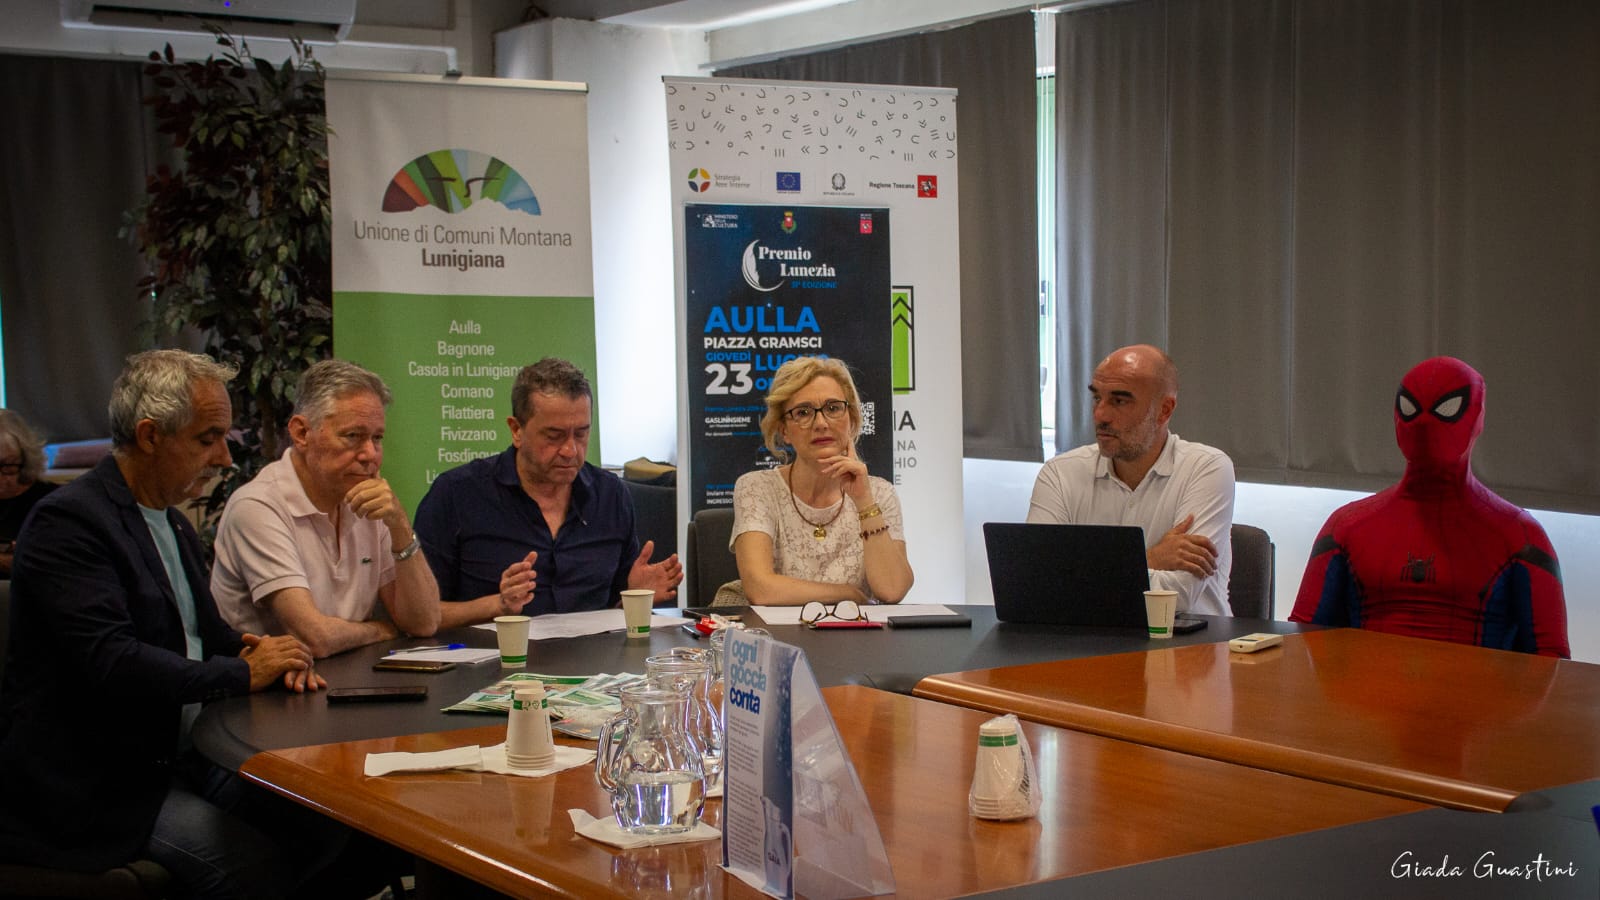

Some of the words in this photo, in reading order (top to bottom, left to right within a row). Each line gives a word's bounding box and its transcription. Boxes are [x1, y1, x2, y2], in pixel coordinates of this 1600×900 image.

[354, 221, 410, 242] Unione
[414, 225, 429, 243] di
[433, 226, 495, 244] Comuni
[499, 227, 572, 247] Montana
[421, 248, 505, 271] Lunigiana
[758, 246, 812, 260] Premio
[780, 263, 836, 277] Lunezia
[449, 320, 481, 334] Aulla
[704, 306, 820, 333] AULLA
[437, 341, 495, 358] Bagnone
[704, 337, 757, 349] PIAZZA
[759, 337, 822, 348] GRAMSCI
[408, 361, 449, 377] Casola
[452, 363, 464, 377] in
[704, 363, 753, 395] 23
[441, 384, 494, 399] Comano
[441, 406, 494, 420] Filattiera
[441, 427, 497, 441] Fivizzano
[731, 640, 758, 666] ogni
[730, 663, 767, 692] goccia
[729, 686, 760, 715] conta
